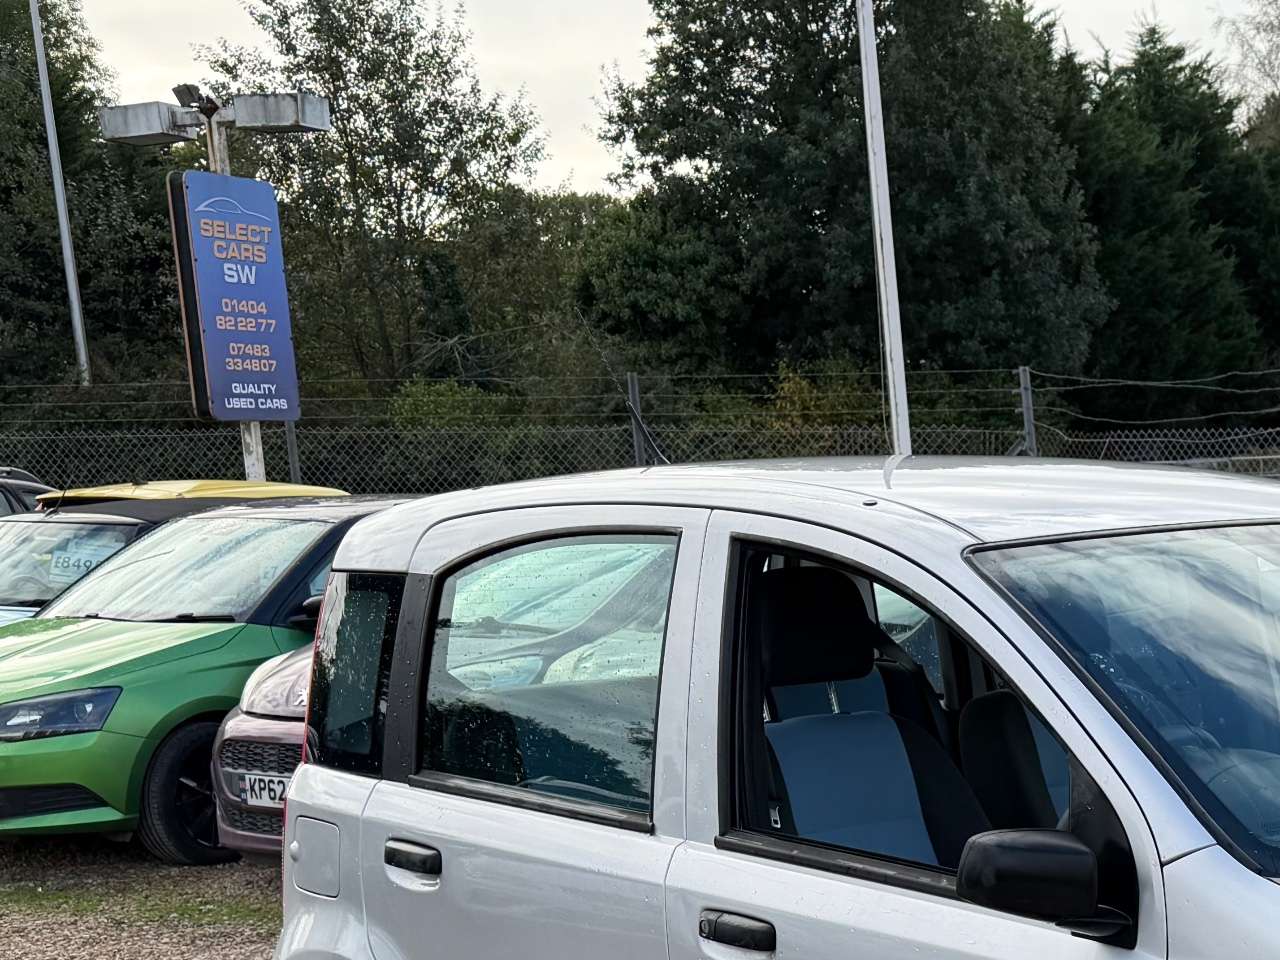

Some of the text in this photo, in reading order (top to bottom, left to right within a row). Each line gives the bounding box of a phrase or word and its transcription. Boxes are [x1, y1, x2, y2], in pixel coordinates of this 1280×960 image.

[201, 219, 271, 243] SELECT
[214, 240, 267, 263] CARS
[223, 263, 256, 284] SW
[222, 298, 267, 314] 01404
[229, 343, 270, 356] 07483
[225, 358, 276, 372] 334807
[232, 383, 276, 394] QUALITY
[225, 398, 288, 409] USED CARS
[248, 776, 286, 801] KP62
